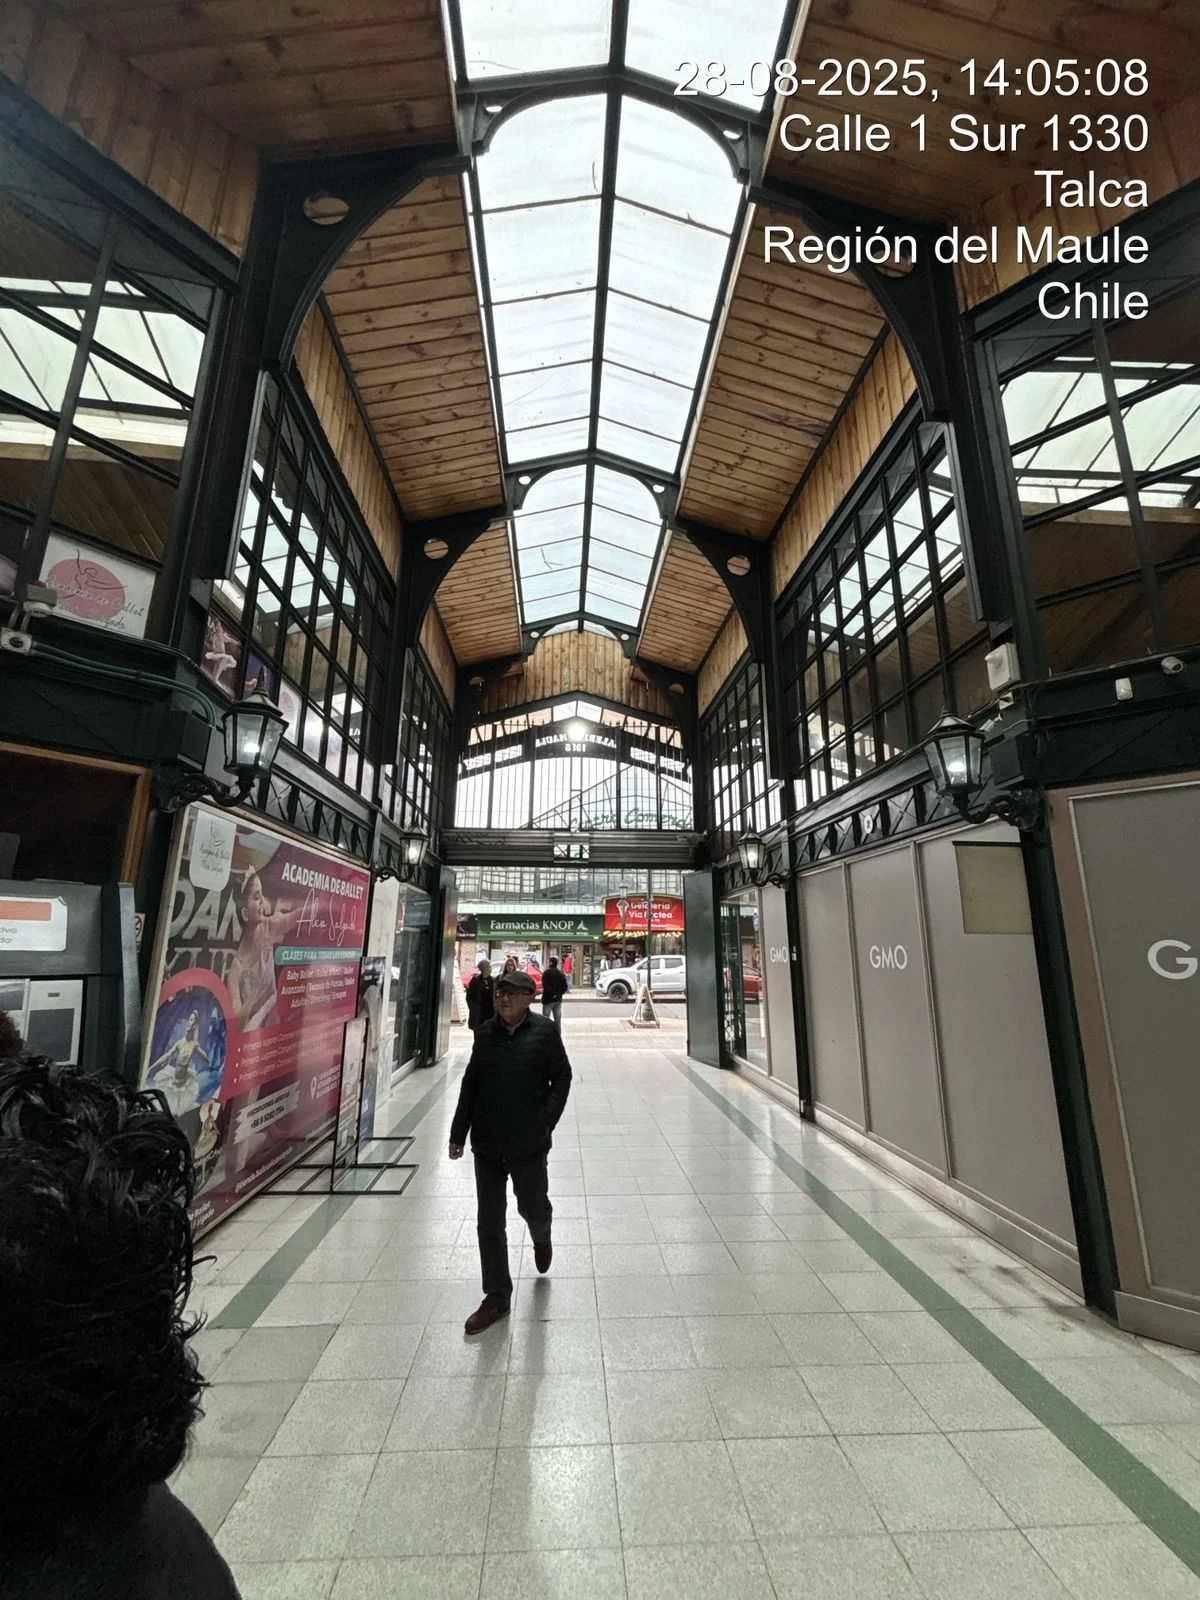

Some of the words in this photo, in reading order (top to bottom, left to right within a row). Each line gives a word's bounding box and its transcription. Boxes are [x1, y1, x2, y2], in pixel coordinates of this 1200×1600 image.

[281, 862, 330, 892] ACADEMIA
[340, 880, 364, 900] BALLET
[490, 920, 540, 930] Farmacias
[542, 920, 574, 930] KNOP
[769, 946, 788, 963] GMO
[869, 944, 908, 970] GMO
[1147, 939, 1199, 980] G
[286, 970, 299, 982] Baby
